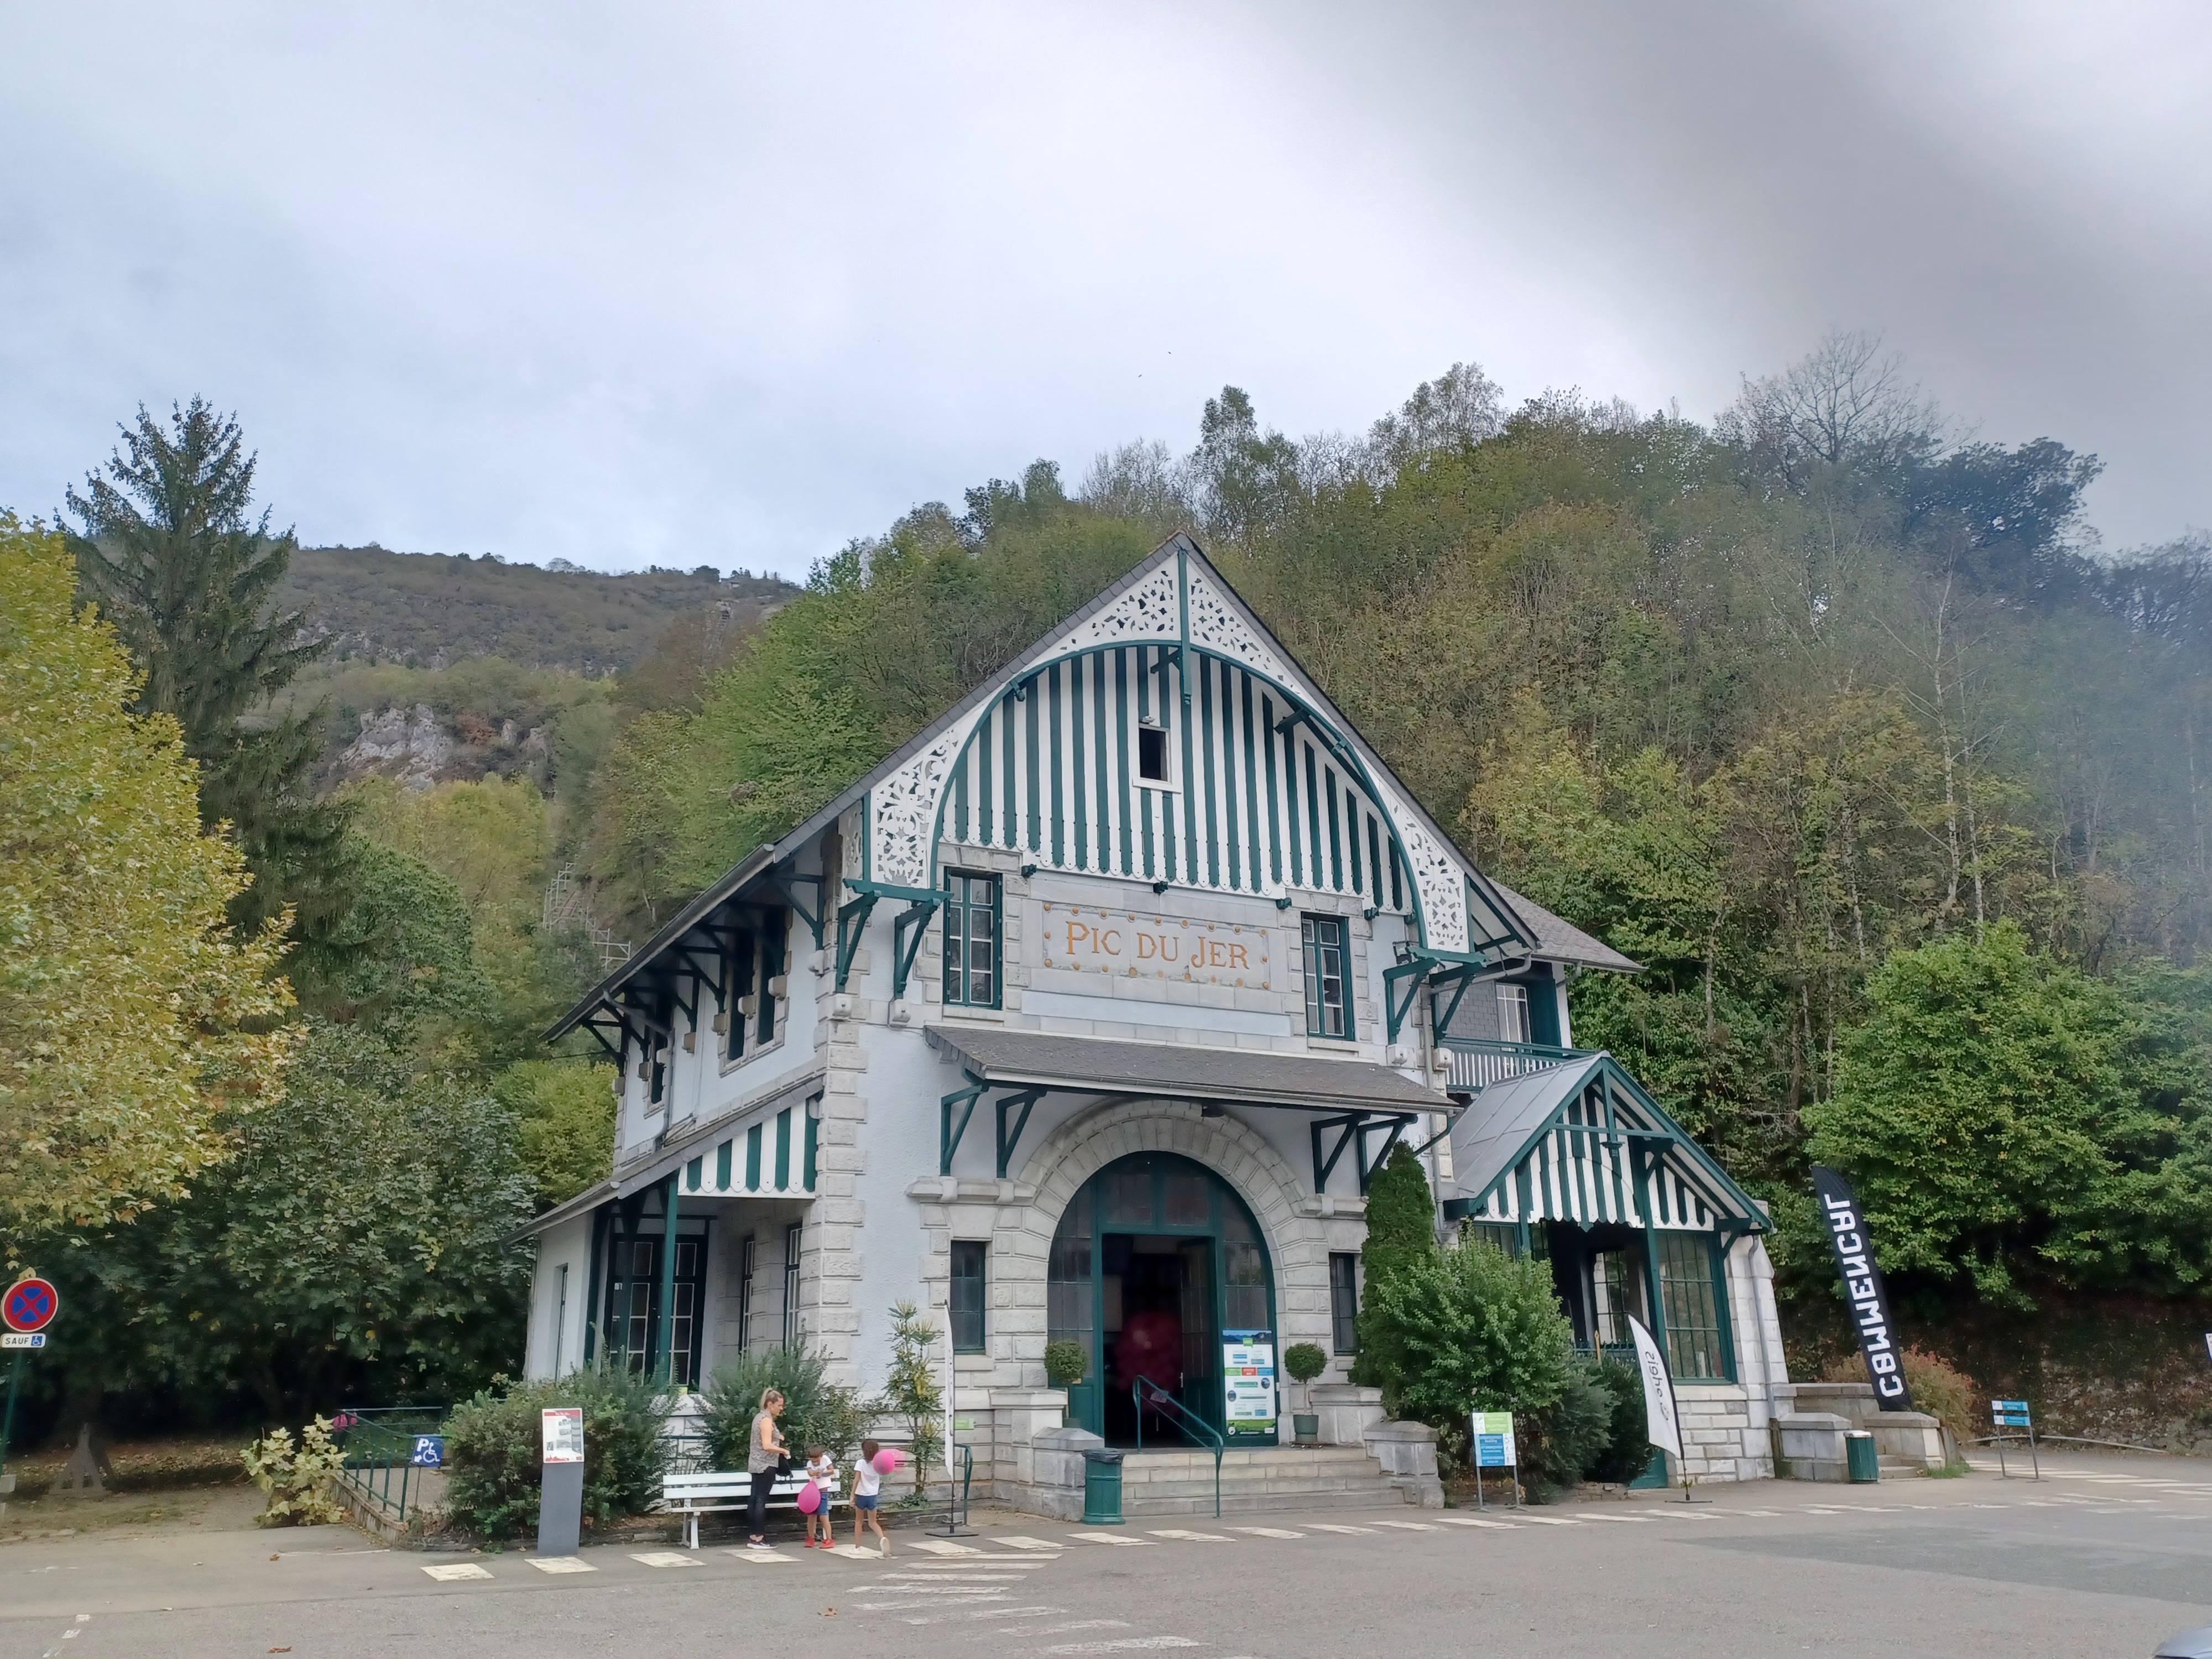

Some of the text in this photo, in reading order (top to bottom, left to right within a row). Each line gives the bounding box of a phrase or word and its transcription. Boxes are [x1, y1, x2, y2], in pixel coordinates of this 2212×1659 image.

[1066, 921, 1250, 969] PIC DU JER
[416, 1438, 429, 1452] P
